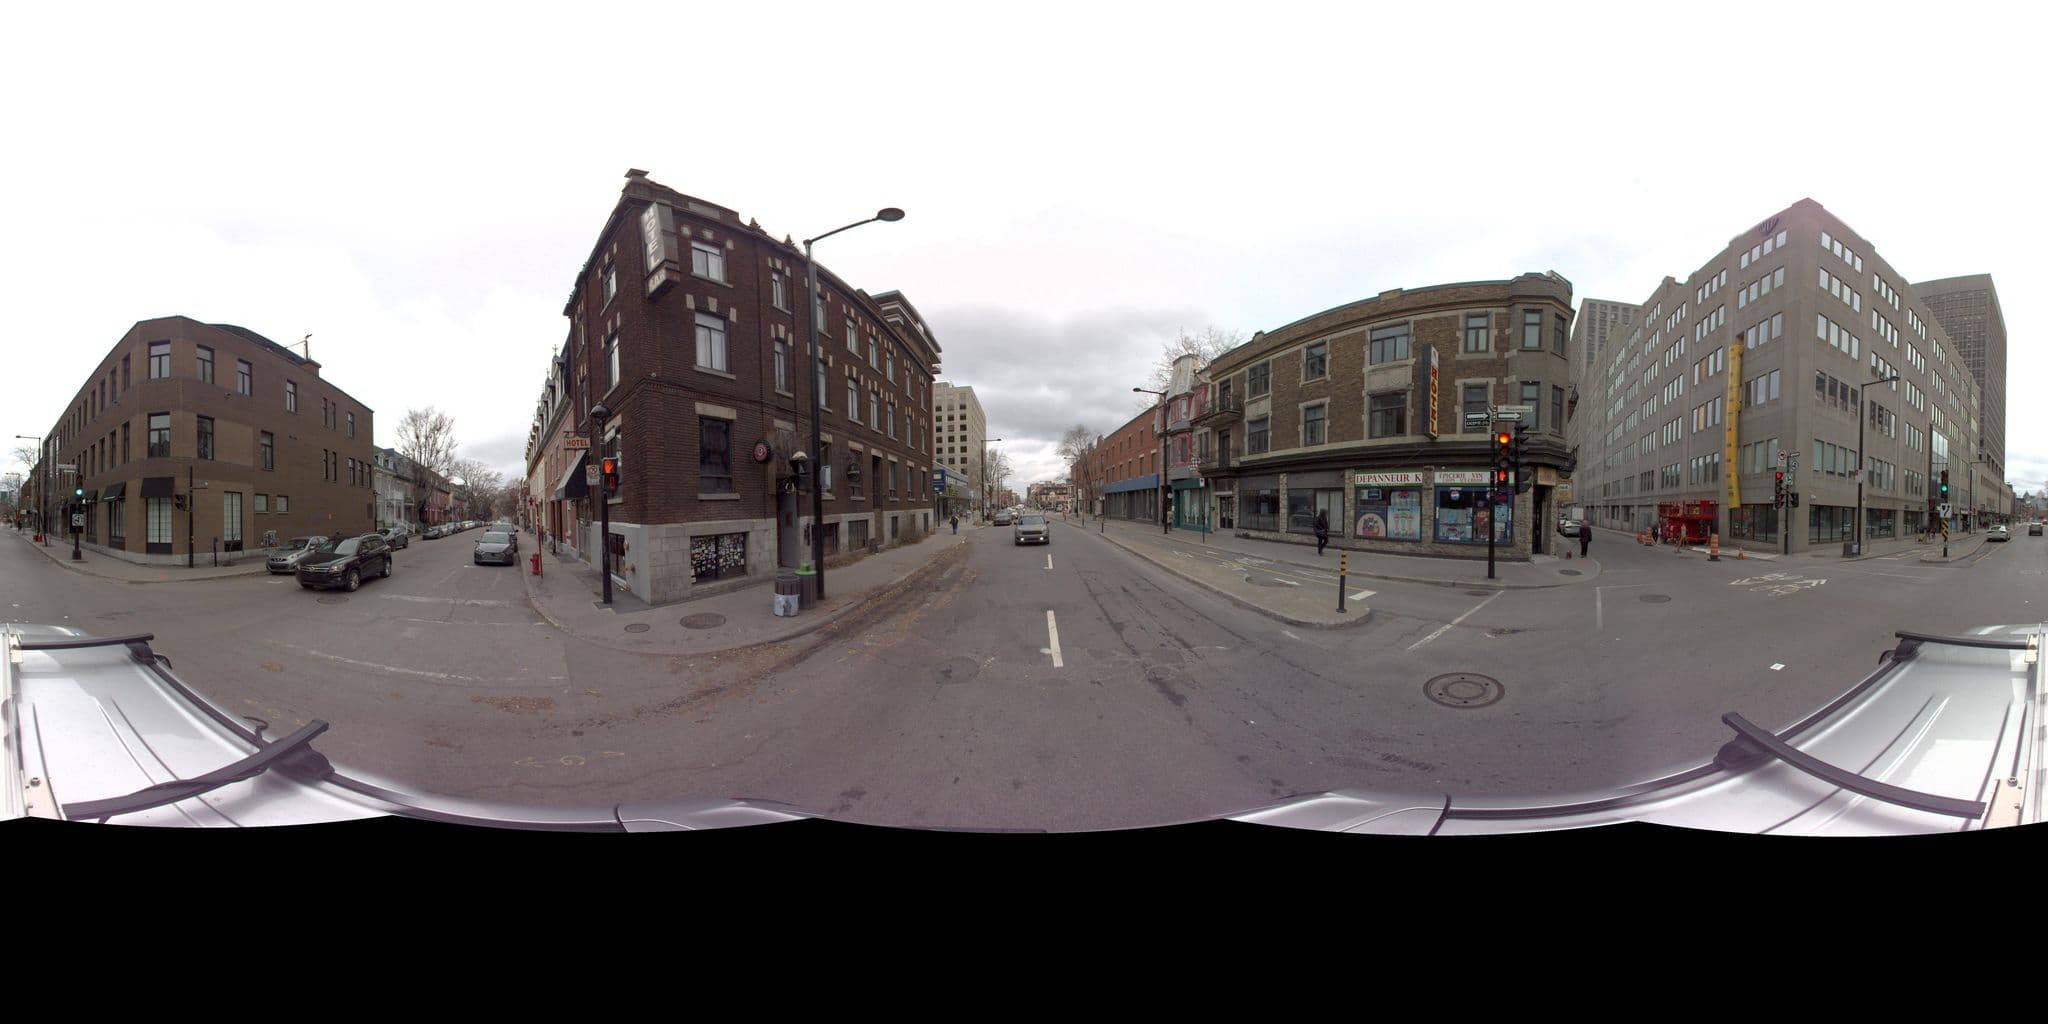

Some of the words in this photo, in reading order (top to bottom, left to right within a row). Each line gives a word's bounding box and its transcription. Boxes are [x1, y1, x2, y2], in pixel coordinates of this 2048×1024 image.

[646, 205, 660, 268] HOTEL
[1430, 367, 1438, 433] HOTEL
[567, 439, 588, 447] HOTEL
[1415, 473, 1422, 482] K
